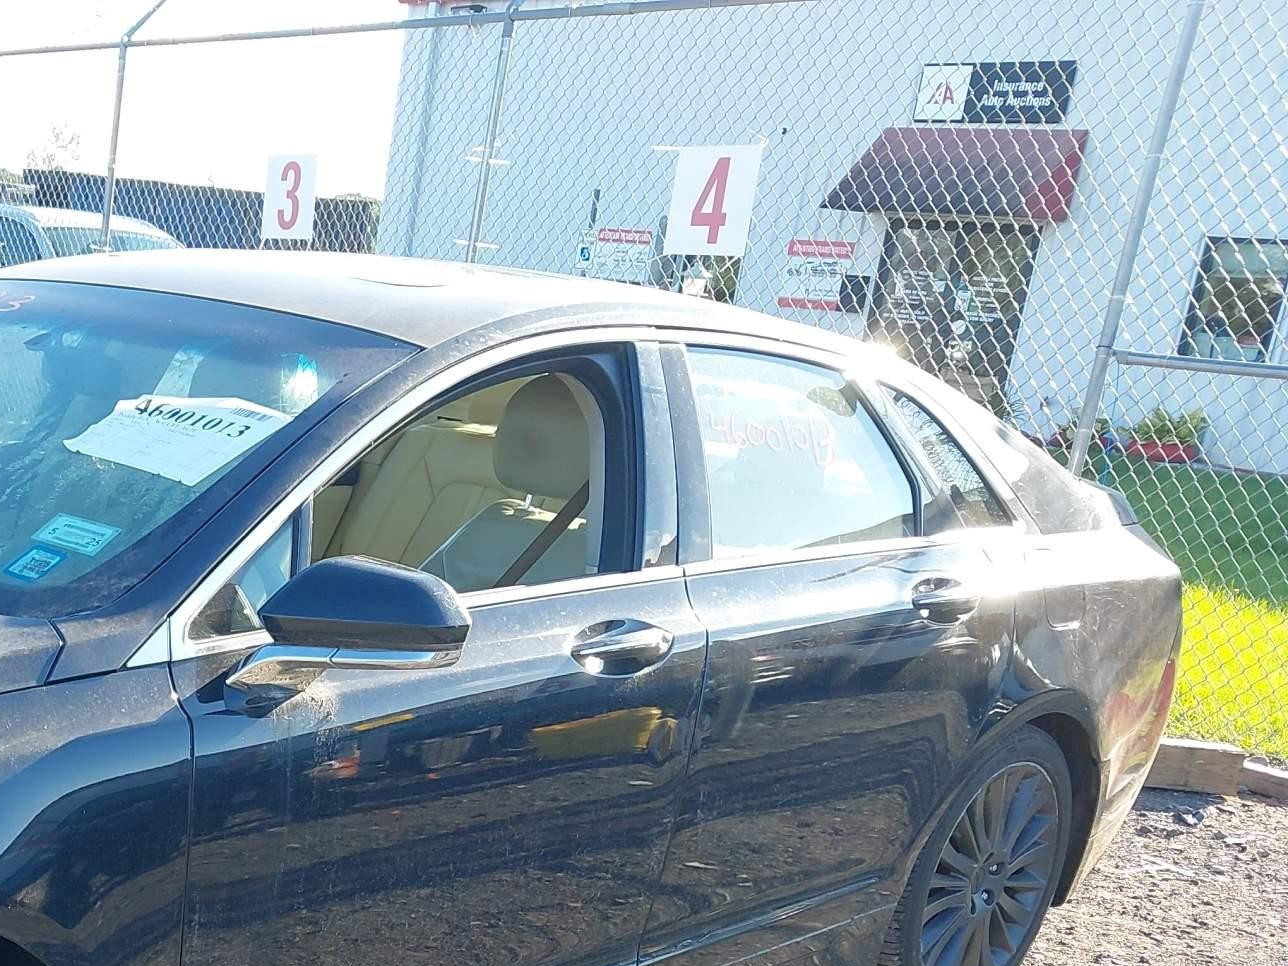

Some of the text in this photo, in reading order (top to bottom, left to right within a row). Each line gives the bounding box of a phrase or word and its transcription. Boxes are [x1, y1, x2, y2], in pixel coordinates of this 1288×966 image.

[980, 94, 1052, 107] Auto Auctions
[993, 78, 1044, 92] Insurance
[277, 161, 302, 231] 3
[690, 156, 731, 244] 4
[134, 398, 252, 439] 46001013
